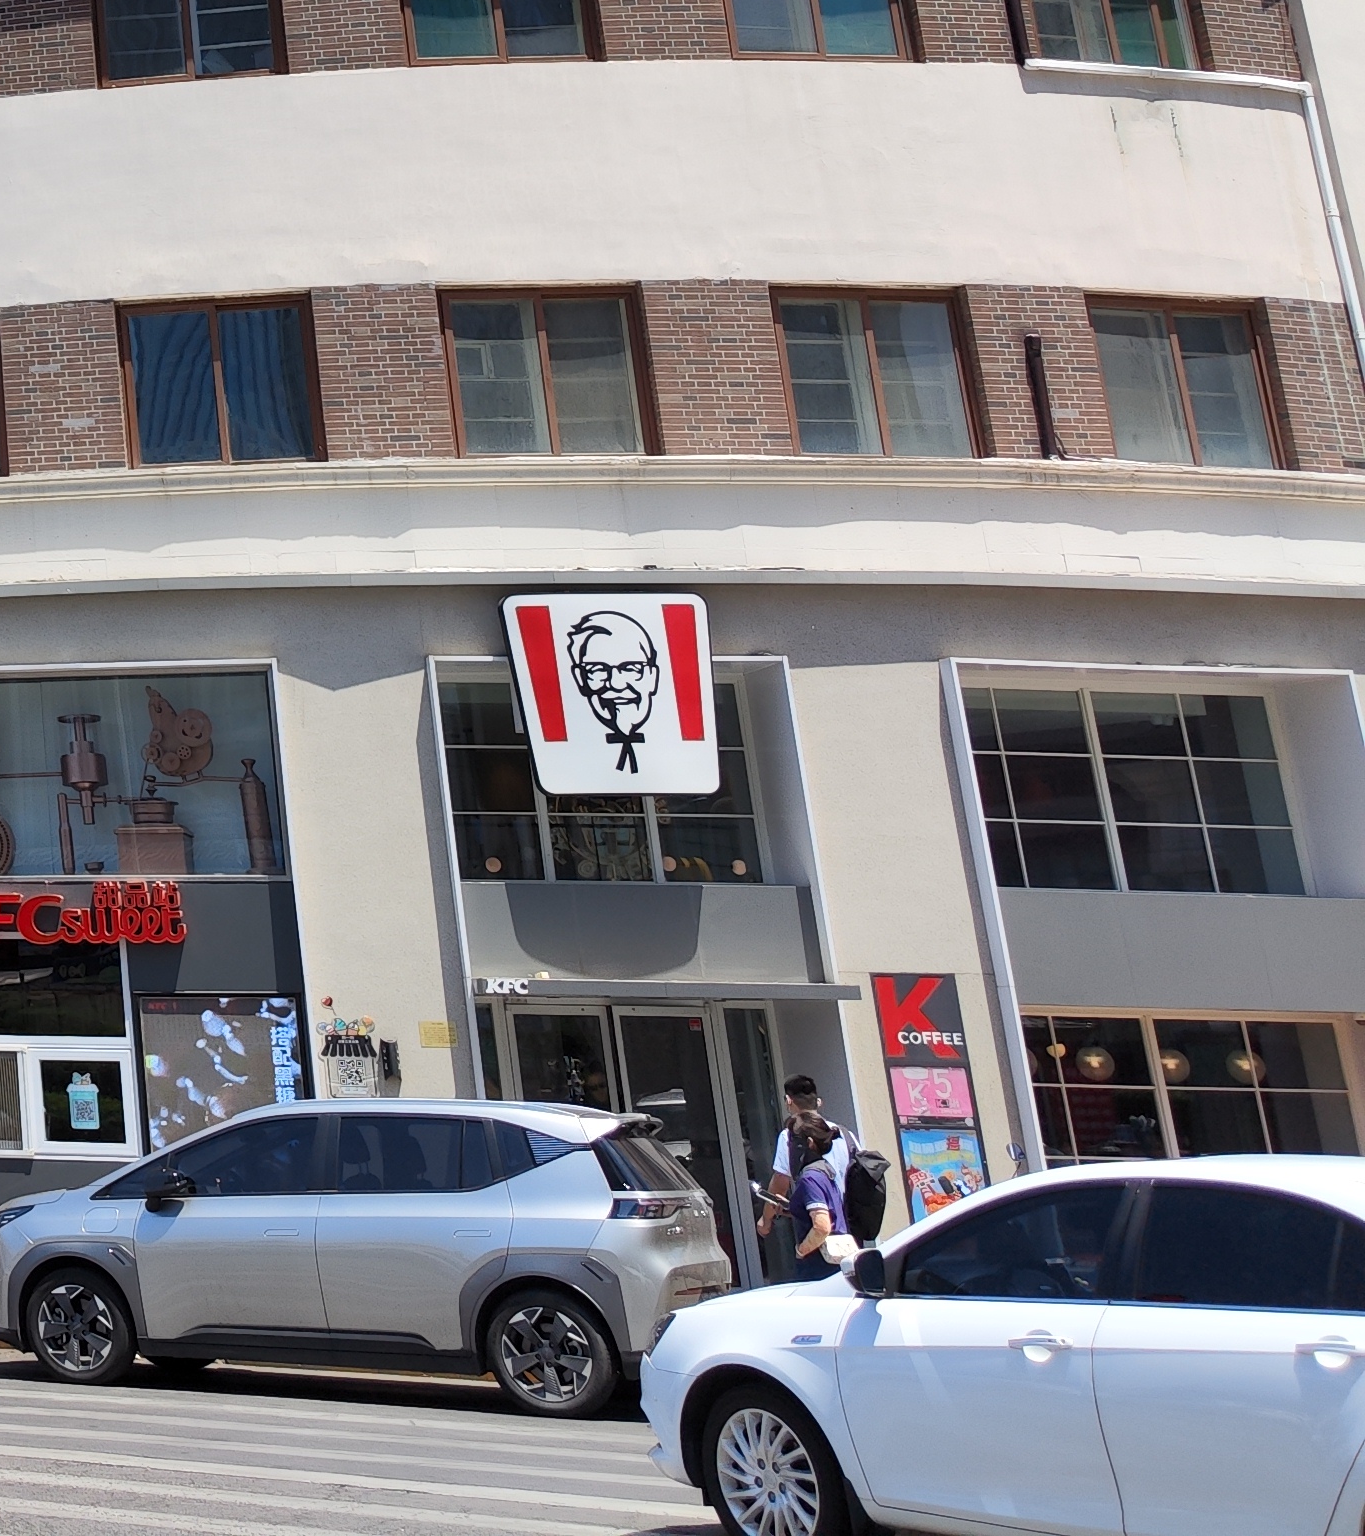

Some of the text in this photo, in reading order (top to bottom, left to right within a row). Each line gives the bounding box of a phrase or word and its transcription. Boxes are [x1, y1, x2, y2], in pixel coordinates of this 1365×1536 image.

[92, 880, 182, 909] 甜品站
[485, 978, 529, 994] KFC
[872, 976, 962, 1059] K
[897, 1031, 964, 1045] COFFEE
